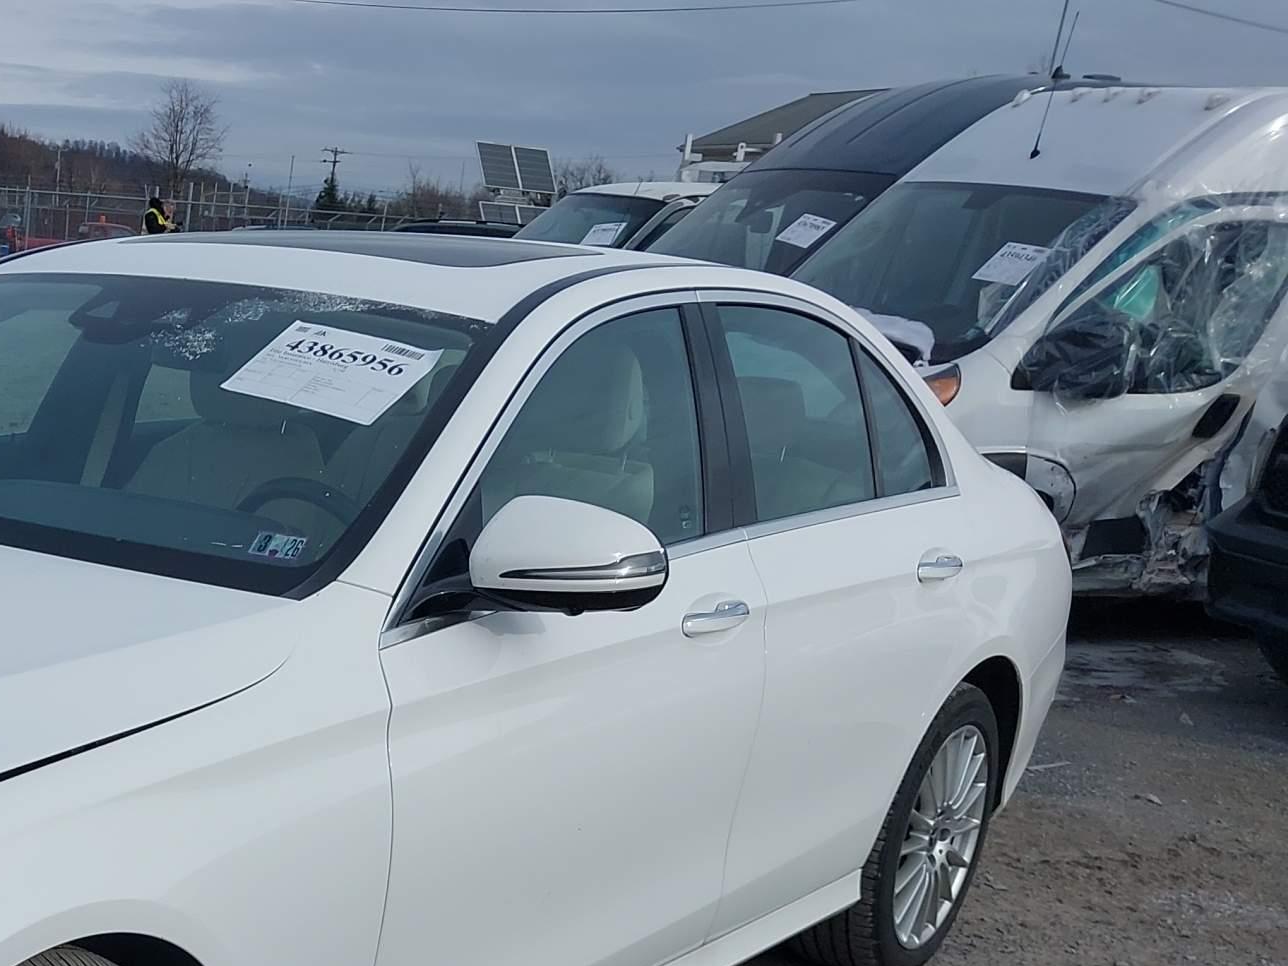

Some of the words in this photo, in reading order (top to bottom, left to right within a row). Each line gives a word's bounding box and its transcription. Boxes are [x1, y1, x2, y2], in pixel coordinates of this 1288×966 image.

[285, 338, 409, 377] 43865956
[257, 535, 273, 553] 3
[284, 539, 305, 557] 26
